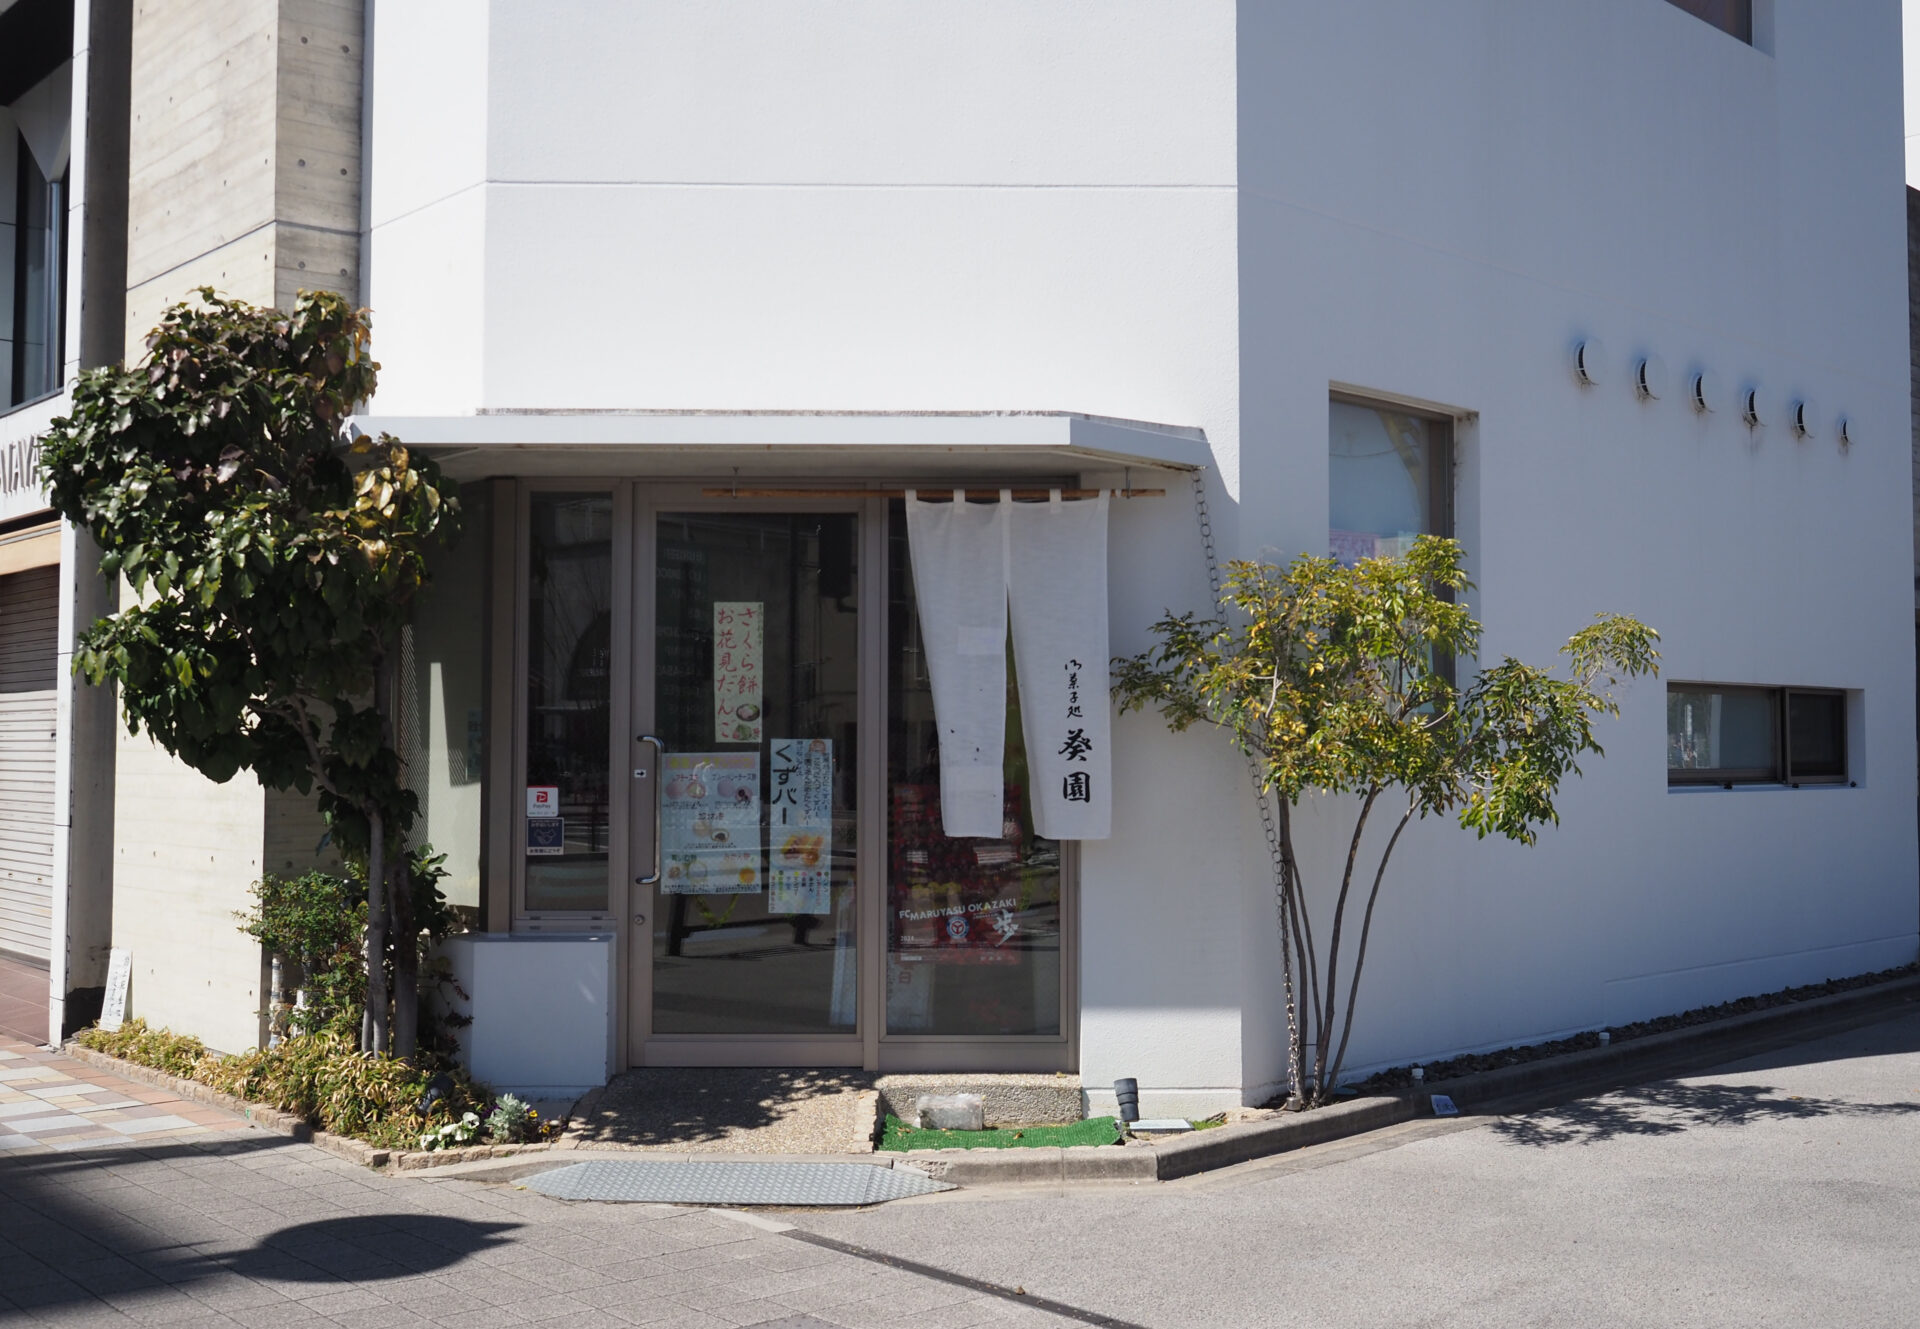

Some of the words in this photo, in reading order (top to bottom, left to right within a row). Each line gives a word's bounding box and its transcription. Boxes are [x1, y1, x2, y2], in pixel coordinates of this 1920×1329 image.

[717, 608, 738, 739] お花見だんご
[737, 607, 759, 696] さくら餅
[772, 744, 798, 824] くずバー
[1058, 728, 1093, 803] 葵園
[909, 905, 966, 921] MARUYASU
[968, 898, 1017, 913] OKAZAKI
